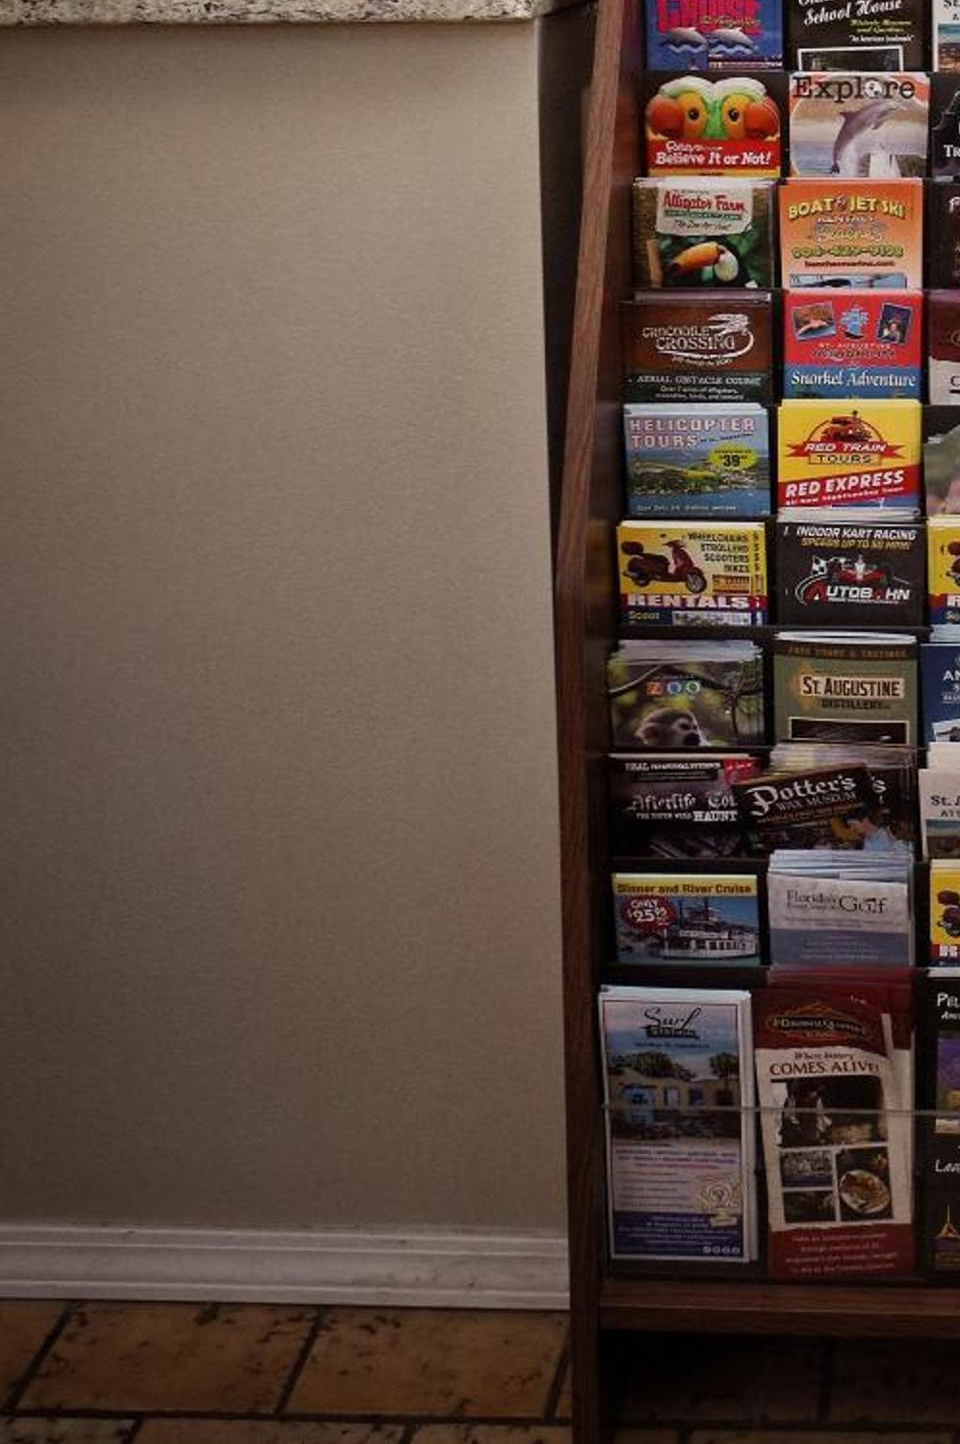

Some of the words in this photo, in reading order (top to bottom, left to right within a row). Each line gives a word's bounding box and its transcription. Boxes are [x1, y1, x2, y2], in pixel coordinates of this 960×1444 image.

[803, 4, 851, 27] School
[793, 75, 916, 102] Explore
[655, 151, 705, 165] Believe
[708, 152, 721, 164] It
[723, 155, 740, 165] or
[741, 151, 771, 165] Not!
[788, 198, 834, 220] BOAT
[849, 196, 877, 211] JET
[882, 200, 905, 218] SKI
[791, 370, 842, 385] Snorkel
[847, 369, 916, 387] Adventure
[630, 418, 755, 433] HELICOPTER
[632, 435, 698, 448] TOURS
[804, 443, 836, 452] RED
[842, 443, 887, 452] TRAIN
[817, 454, 872, 463] TOURS
[785, 481, 821, 498] RED
[825, 470, 905, 493] EXPRESS
[797, 526, 840, 538] INDOOR
[842, 527, 872, 539] KART
[874, 529, 916, 541] RACING
[627, 594, 749, 609] RENTALS
[824, 678, 900, 697] AUGUSTINE
[744, 775, 856, 816] Potter's
[930, 795, 951, 806] St.
[659, 884, 679, 892] and
[682, 884, 712, 893] River
[715, 884, 752, 893] Cruise
[644, 1007, 701, 1030] Surf
[770, 1061, 825, 1076] COMES
